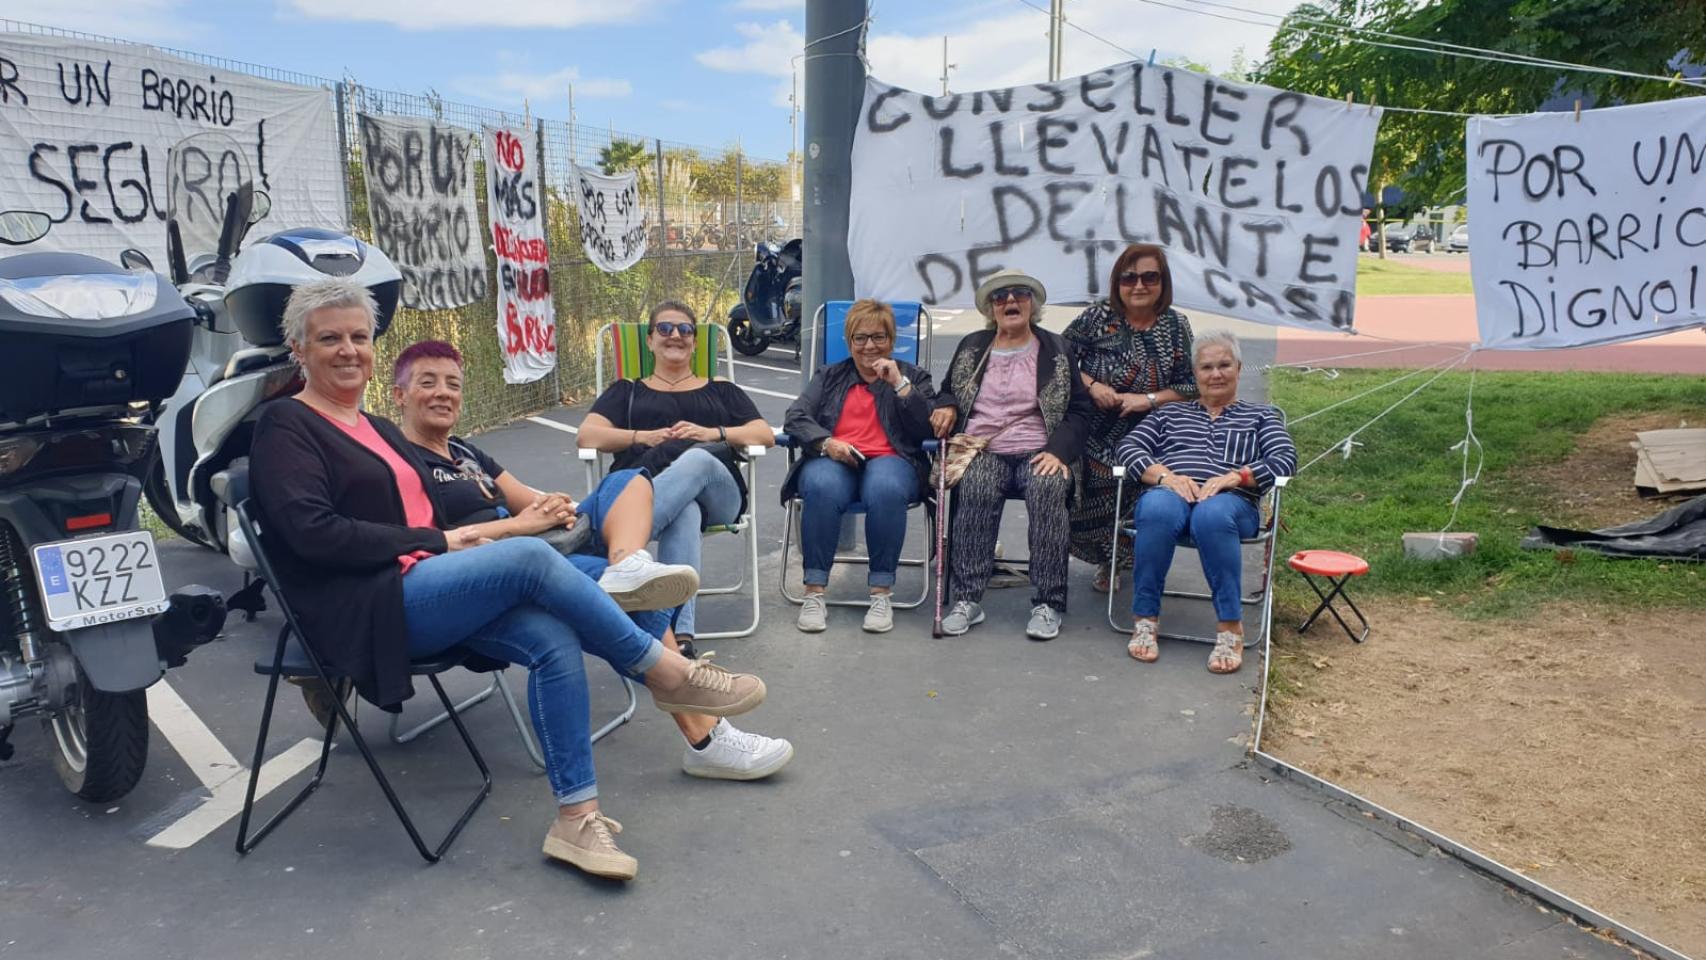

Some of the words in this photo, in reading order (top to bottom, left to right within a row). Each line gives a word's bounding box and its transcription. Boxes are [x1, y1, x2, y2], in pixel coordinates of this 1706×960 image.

[58, 60, 111, 107] UN
[868, 63, 1311, 157] CONSELLER
[496, 130, 525, 172] NO
[939, 116, 1368, 217] LLEVATELOS
[1478, 138, 1597, 203] POR
[1633, 132, 1706, 186] UN
[992, 181, 1339, 283] DELANTE
[66, 540, 153, 579] 9222
[50, 575, 61, 587] E
[72, 572, 139, 611] KZZ
[82, 603, 163, 626] MotorSet
